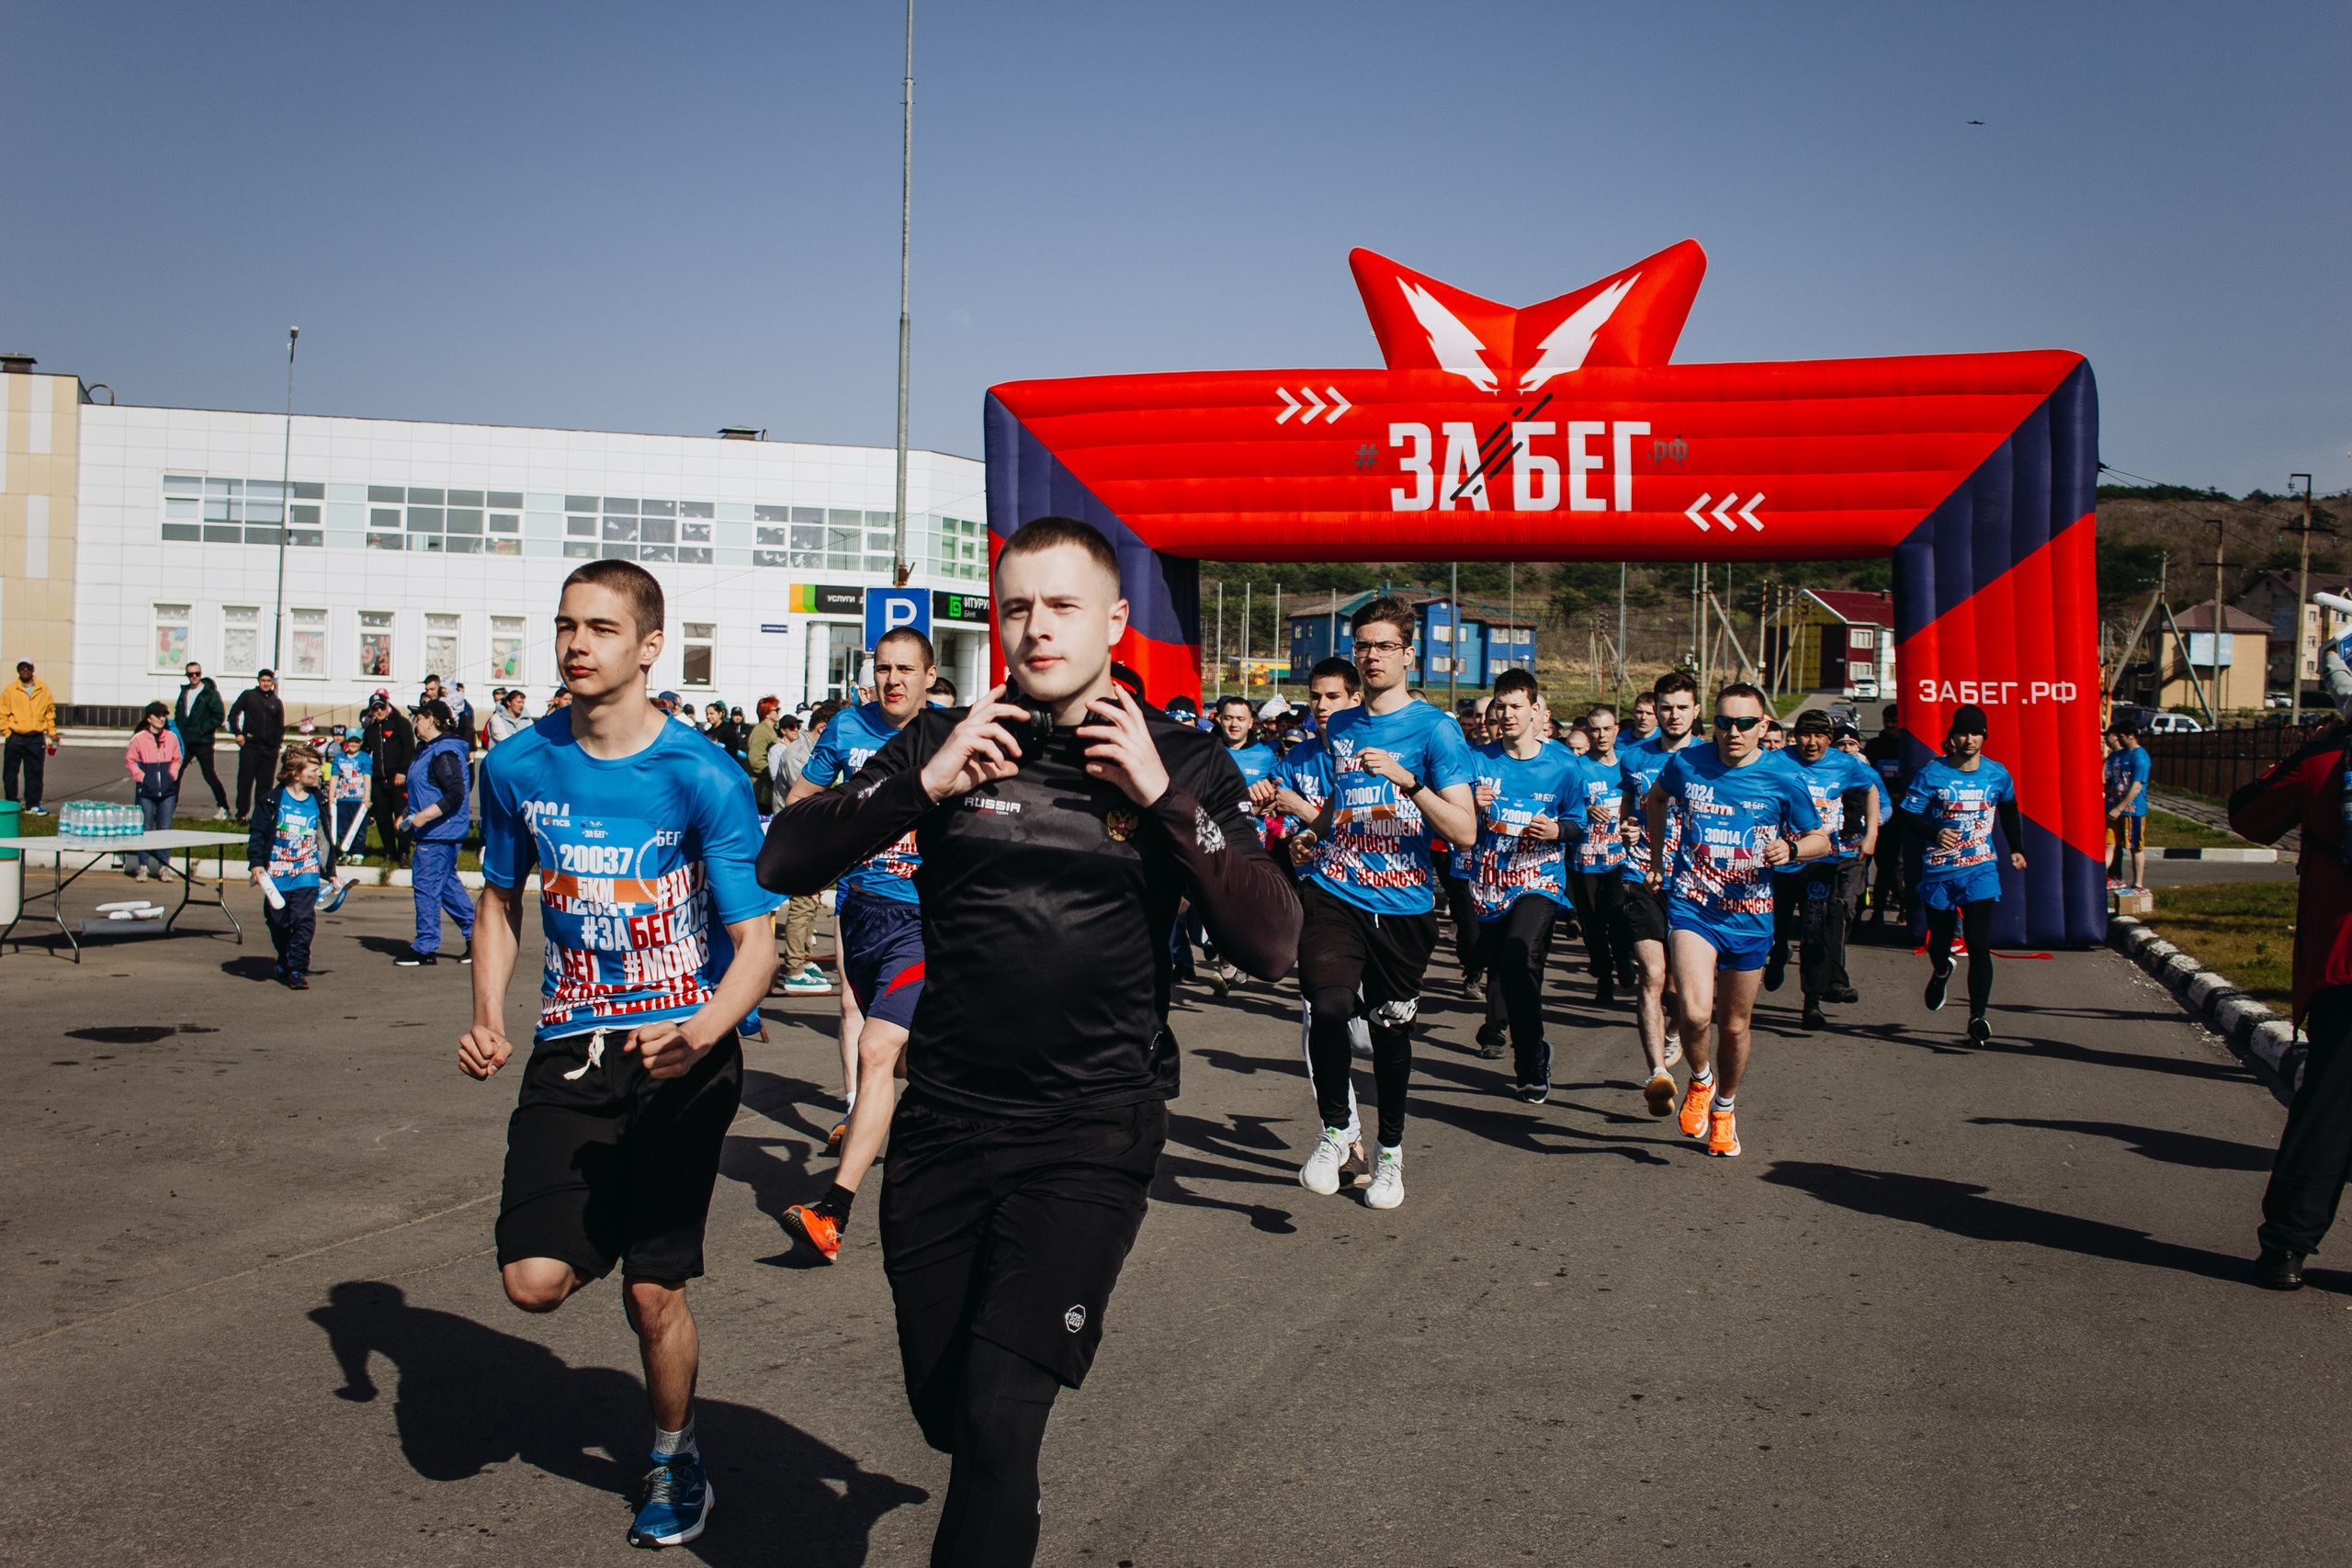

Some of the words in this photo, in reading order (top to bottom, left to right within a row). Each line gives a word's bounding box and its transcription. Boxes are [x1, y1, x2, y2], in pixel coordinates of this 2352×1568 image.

[827, 594, 855, 603] УСЛУГИ
[886, 598, 917, 632] P
[1918, 679, 2076, 705] ЗАБЕГ.РФ
[1345, 785, 1381, 807] 20007
[1685, 782, 1714, 804] 2024
[965, 797, 1022, 813] RUSSIA
[1500, 807, 1533, 826] 20018
[1704, 828, 1742, 845] 30014
[560, 843, 634, 874] 20037
[1384, 852, 1417, 872] 2024
